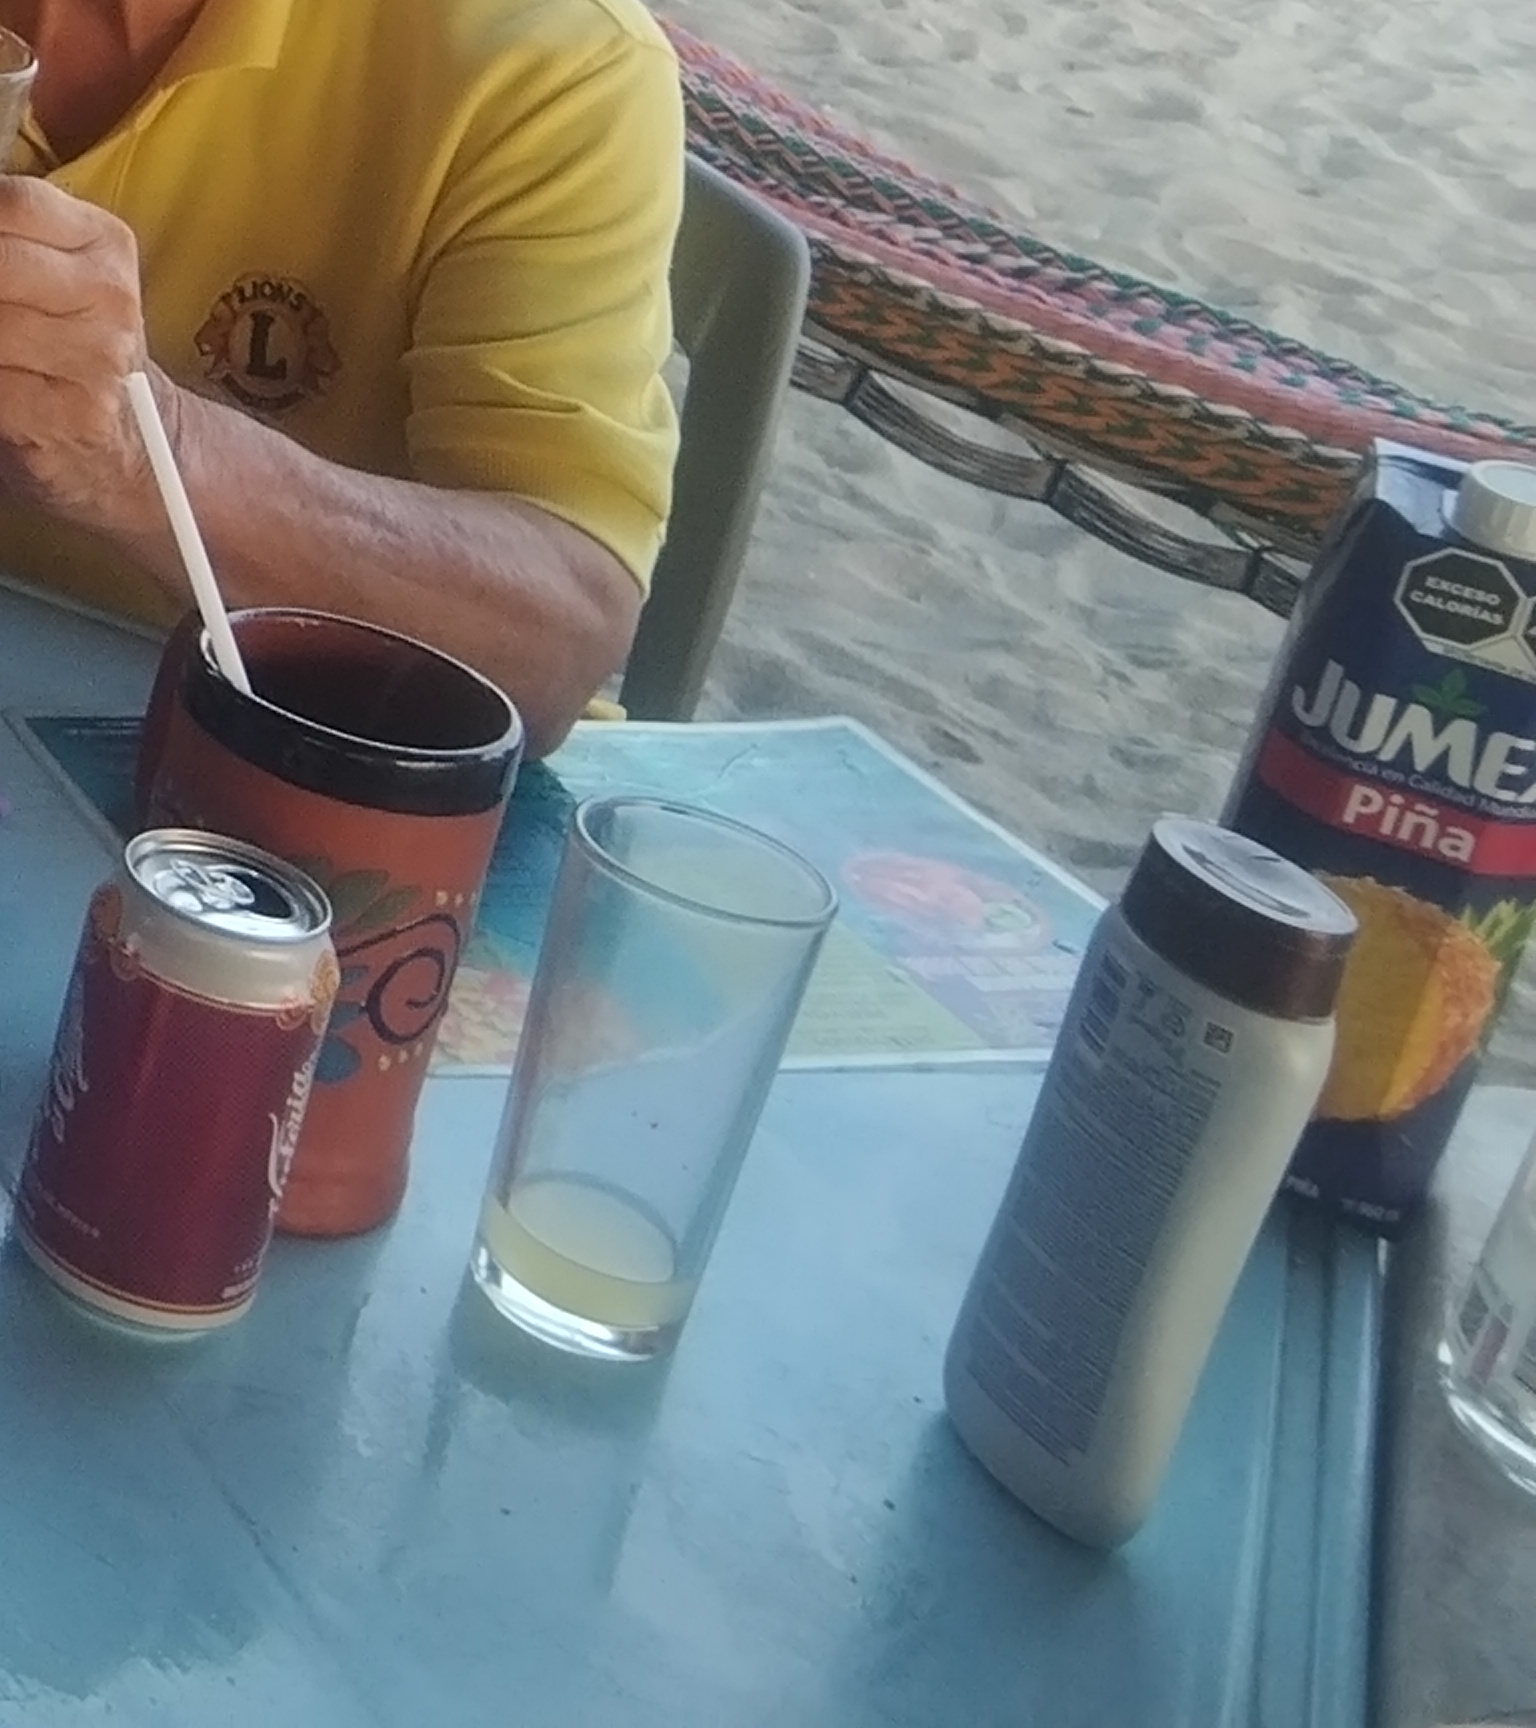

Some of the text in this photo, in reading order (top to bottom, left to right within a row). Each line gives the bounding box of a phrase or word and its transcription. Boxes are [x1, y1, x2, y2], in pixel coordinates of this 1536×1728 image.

[234, 280, 307, 312] LIONS
[246, 311, 287, 380] L
[1410, 590, 1504, 625] CALORÍAS
[1424, 576, 1501, 606] EXCESO
[1291, 658, 1536, 804] JUME
[1342, 784, 1477, 863] Piña
